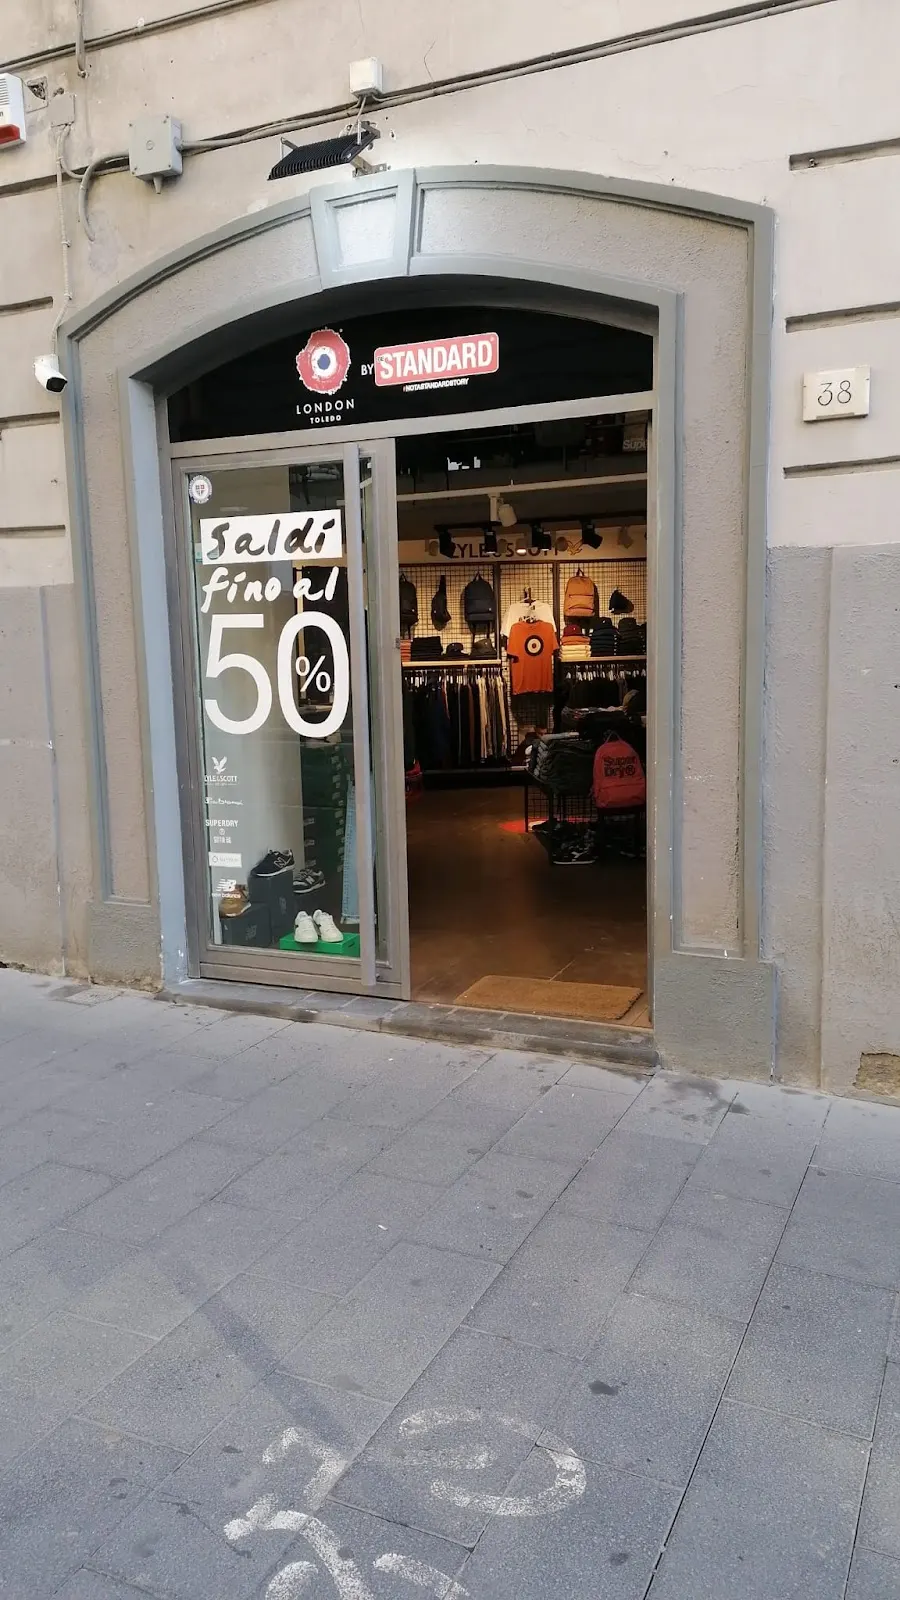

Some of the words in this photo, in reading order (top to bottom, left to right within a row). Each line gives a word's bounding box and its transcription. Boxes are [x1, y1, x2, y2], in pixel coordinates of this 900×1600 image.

[360, 363, 374, 376] BY
[380, 340, 492, 379] STANDARD
[817, 379, 852, 406] 38
[296, 399, 355, 414] LONDON
[310, 414, 342, 424] TOLEDO
[200, 566, 282, 614] fino
[292, 566, 339, 601] al
[205, 819, 239, 828] SUPERDRY
